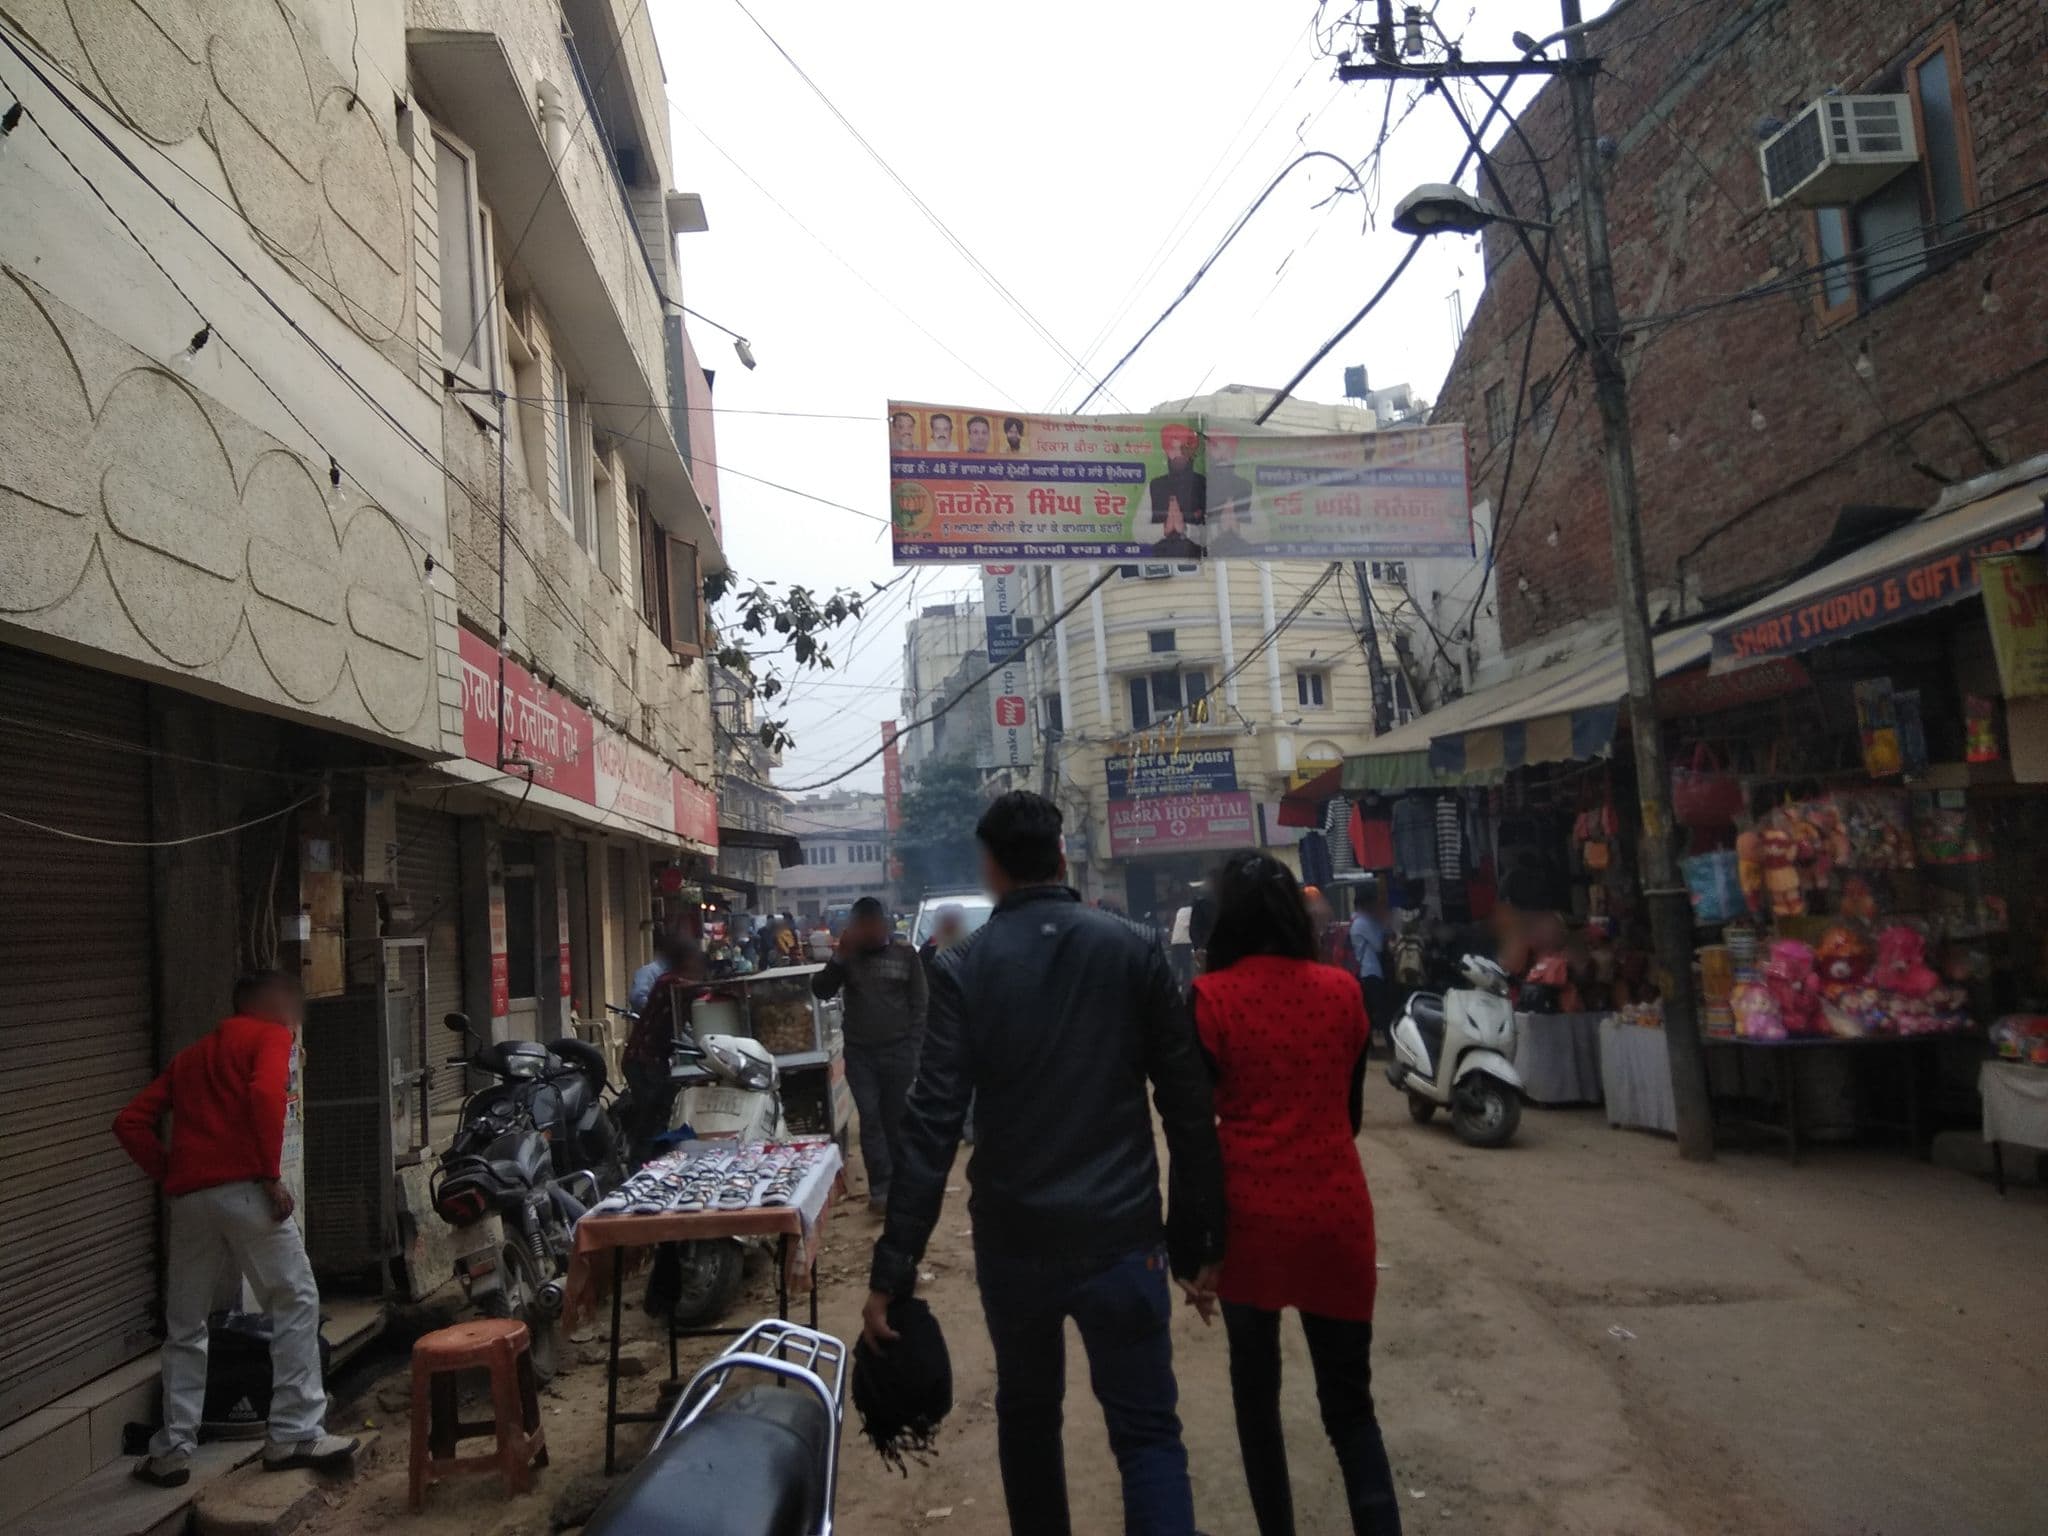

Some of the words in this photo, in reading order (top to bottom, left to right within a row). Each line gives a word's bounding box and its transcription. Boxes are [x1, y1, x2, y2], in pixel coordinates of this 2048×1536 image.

[932, 462, 947, 474] 48
[935, 482, 1014, 517] ਜਰਨੈਲ
[1027, 487, 1083, 516] ਸਿੰਘ
[1094, 489, 1129, 516] ਢੋਟ
[997, 576, 1008, 613] make
[1731, 612, 1793, 659] SMART
[1798, 586, 1876, 639] STUDIO
[1883, 579, 1901, 611] &
[1906, 555, 1962, 602] GIFT
[457, 655, 515, 736] ਨਾਗਪਲ
[1004, 671, 1016, 695] trip
[1006, 729, 1019, 765] make
[1157, 755, 1167, 767] &
[1170, 750, 1232, 767] DRUGGIST
[1113, 805, 1162, 826] ARORA
[1165, 800, 1248, 822] HOSPITAL
